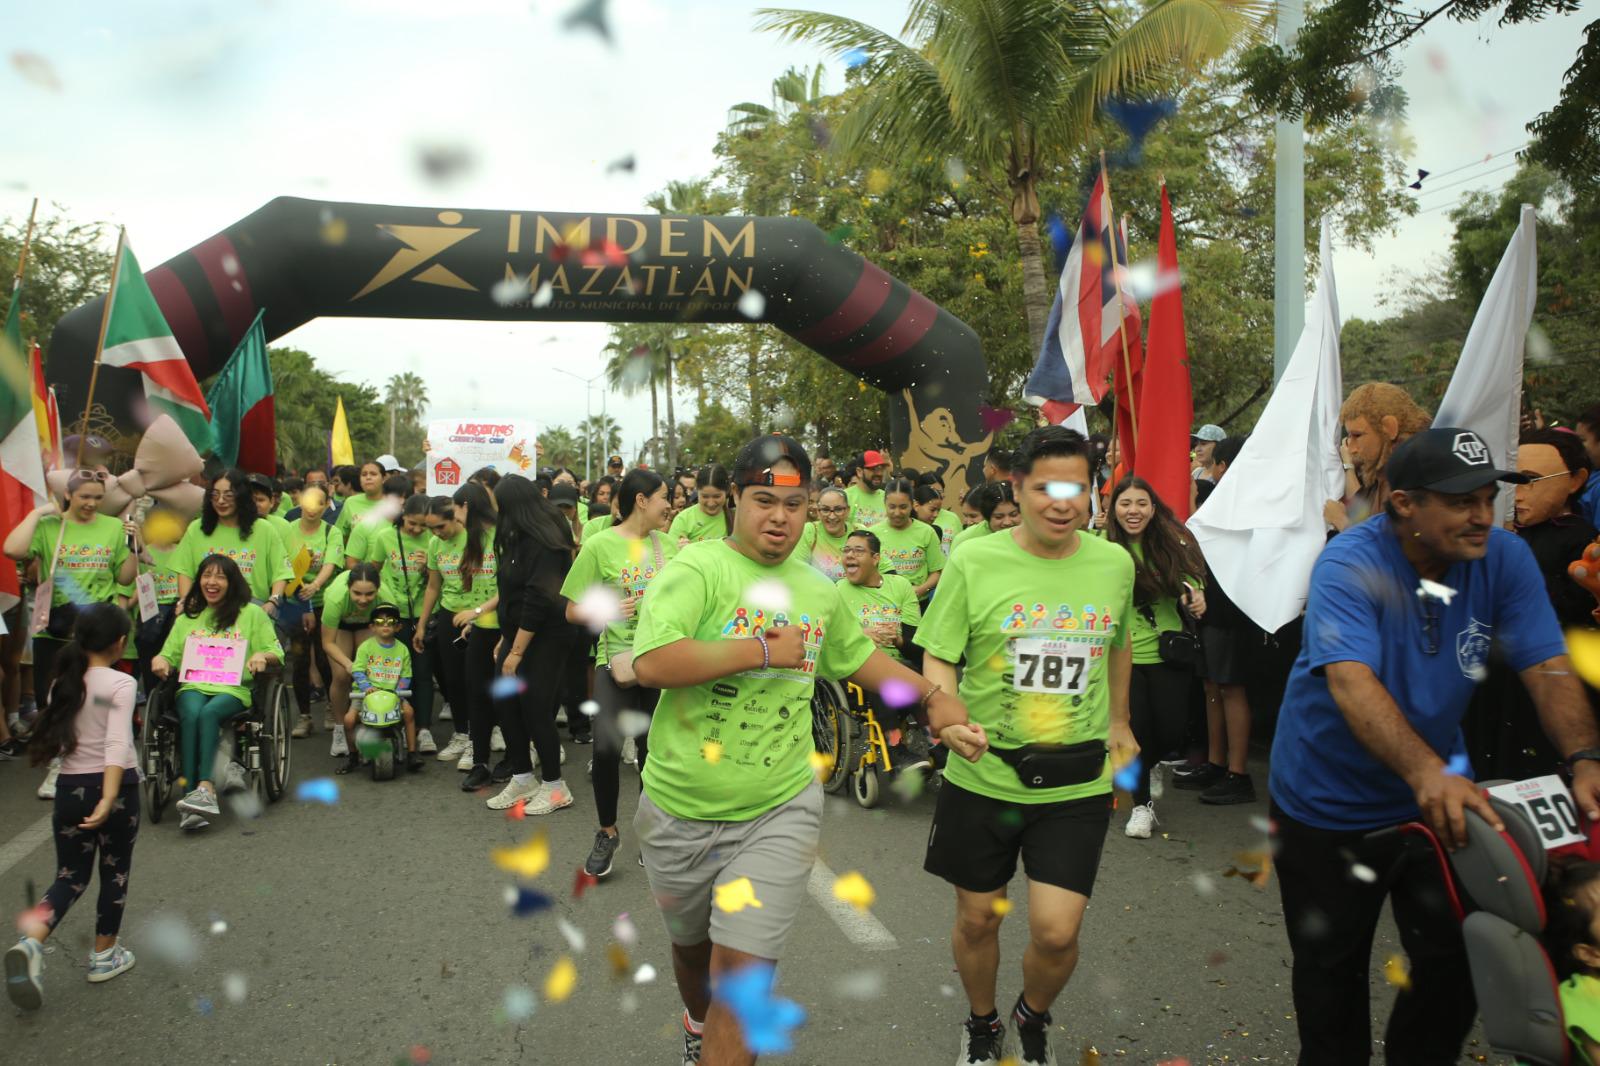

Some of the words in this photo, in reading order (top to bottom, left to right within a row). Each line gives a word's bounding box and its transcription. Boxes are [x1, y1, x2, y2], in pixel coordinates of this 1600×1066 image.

[507, 214, 755, 257] IMDEM
[504, 258, 753, 296] MAZATLÁN
[582, 301, 654, 310] MUNICIPAL
[1019, 654, 1085, 690] 787
